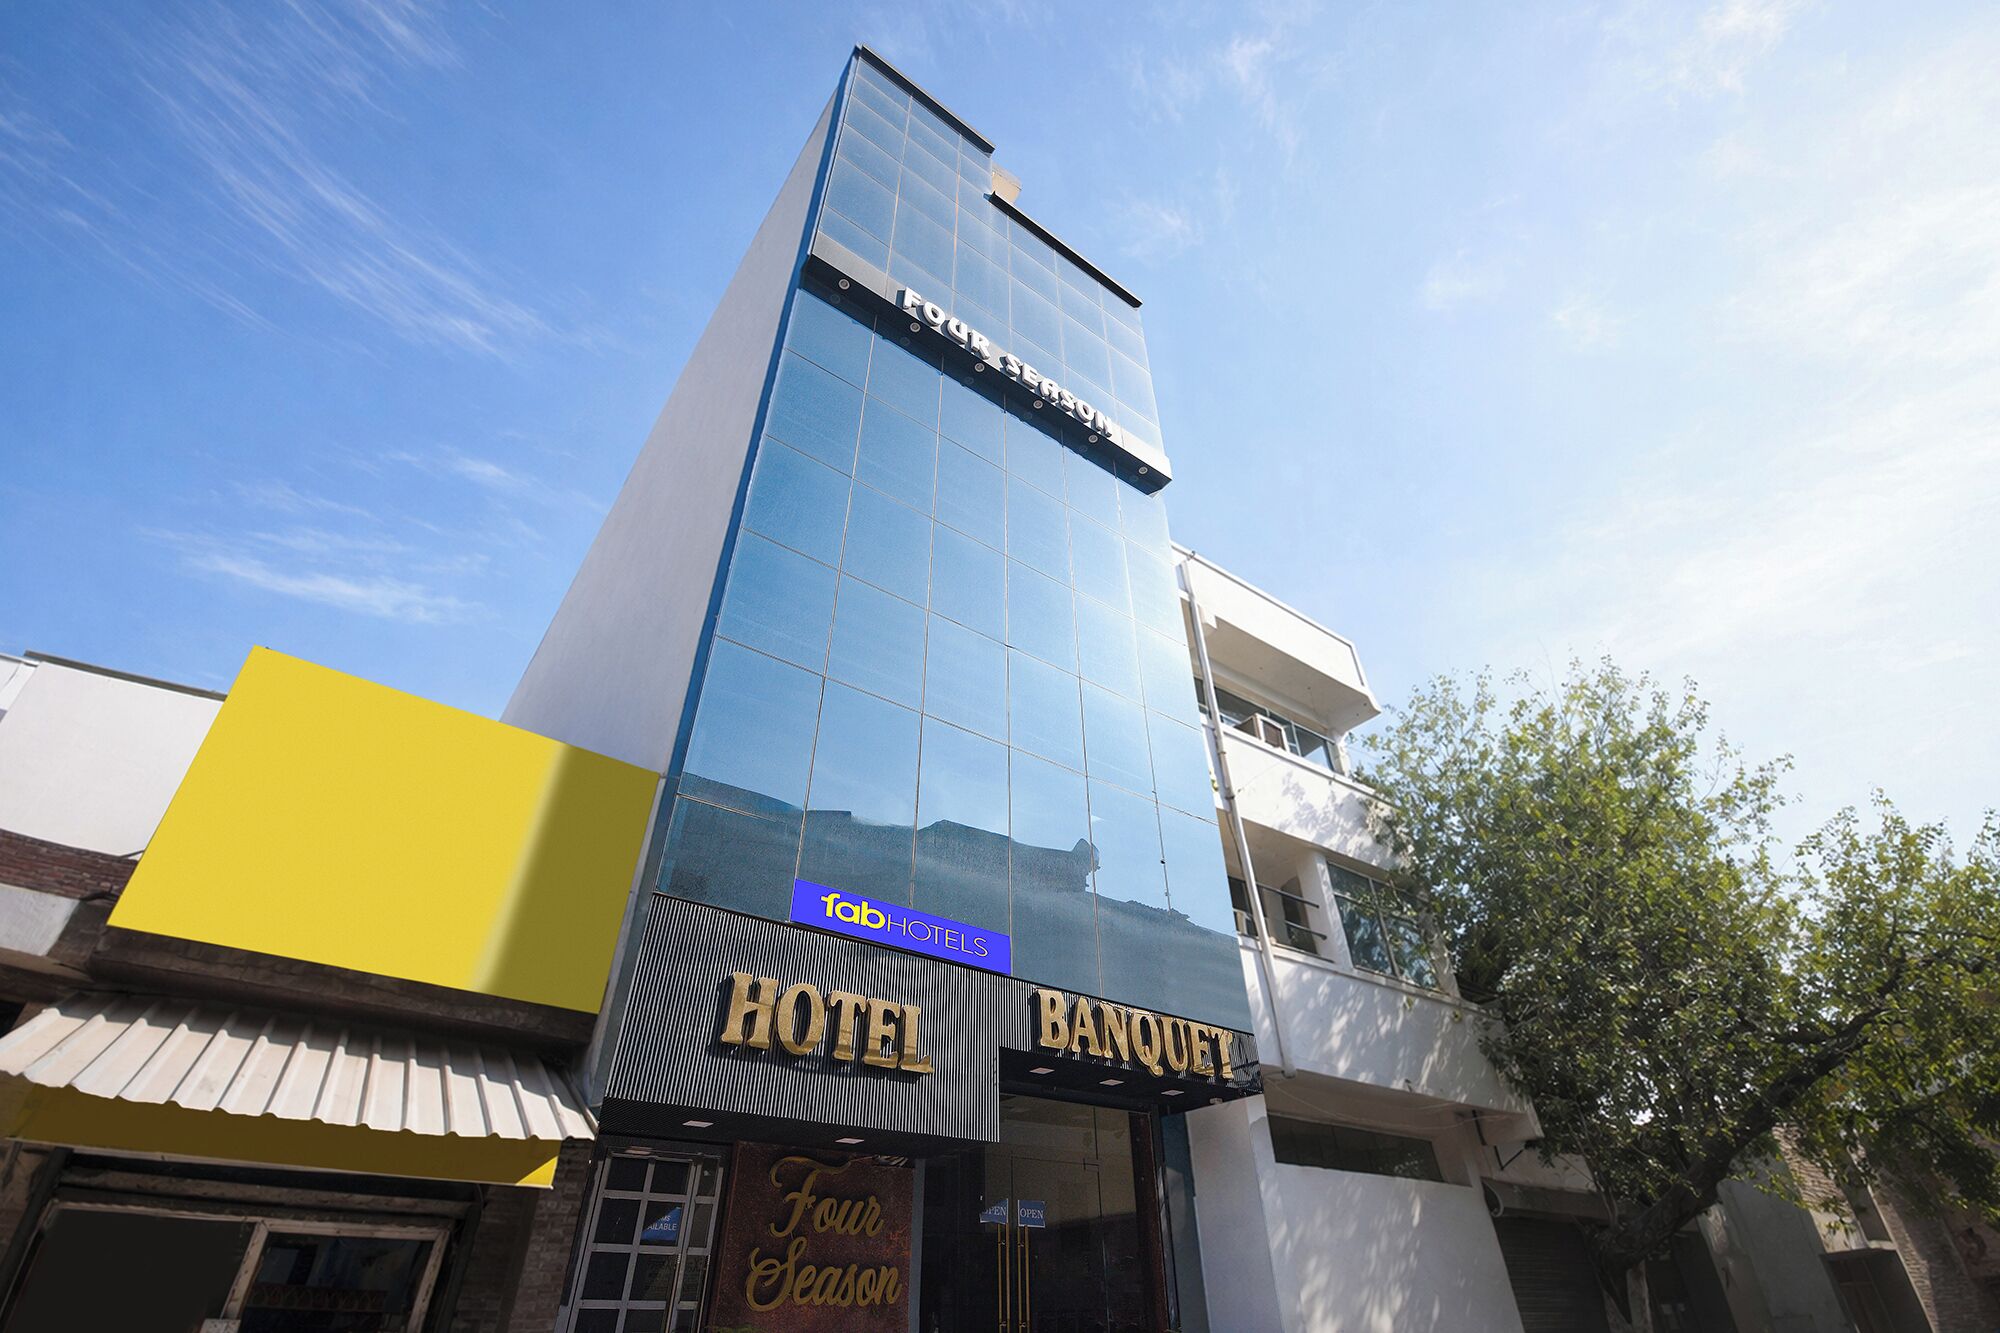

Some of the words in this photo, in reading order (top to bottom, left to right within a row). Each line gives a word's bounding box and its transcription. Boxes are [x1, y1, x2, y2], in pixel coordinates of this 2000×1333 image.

[900, 287, 991, 360] FOUR
[1002, 353, 1113, 438] SEASON
[720, 972, 934, 1075] HOTEL
[1037, 988, 1234, 1080] BANQUET
[768, 1156, 885, 1239] Four
[1019, 1207, 1044, 1219] OPEN
[745, 1236, 902, 1312] Season
